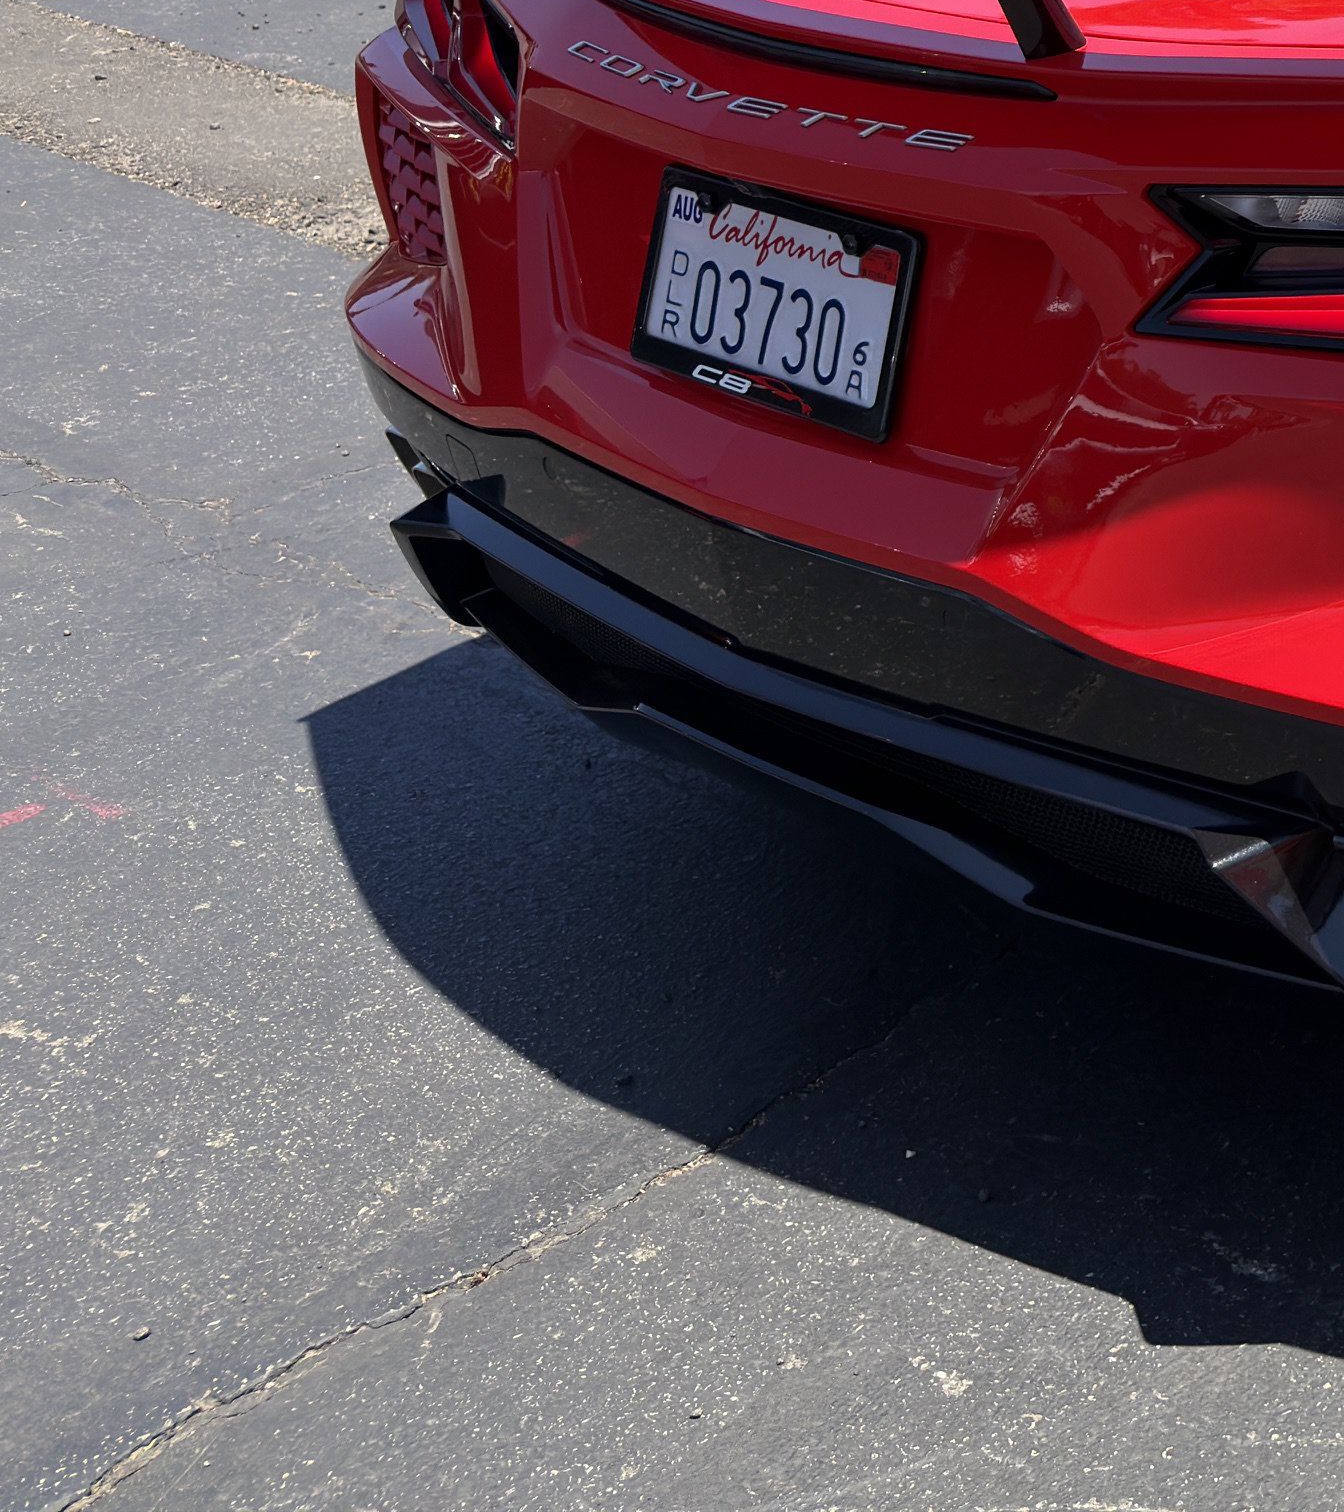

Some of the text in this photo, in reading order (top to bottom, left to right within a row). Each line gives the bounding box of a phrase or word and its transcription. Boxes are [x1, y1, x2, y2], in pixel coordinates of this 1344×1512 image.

[567, 40, 975, 152] CORVETTE
[672, 194, 703, 224] AUG
[709, 202, 860, 278] California
[690, 260, 846, 385] 03730
[692, 364, 750, 393] C8
